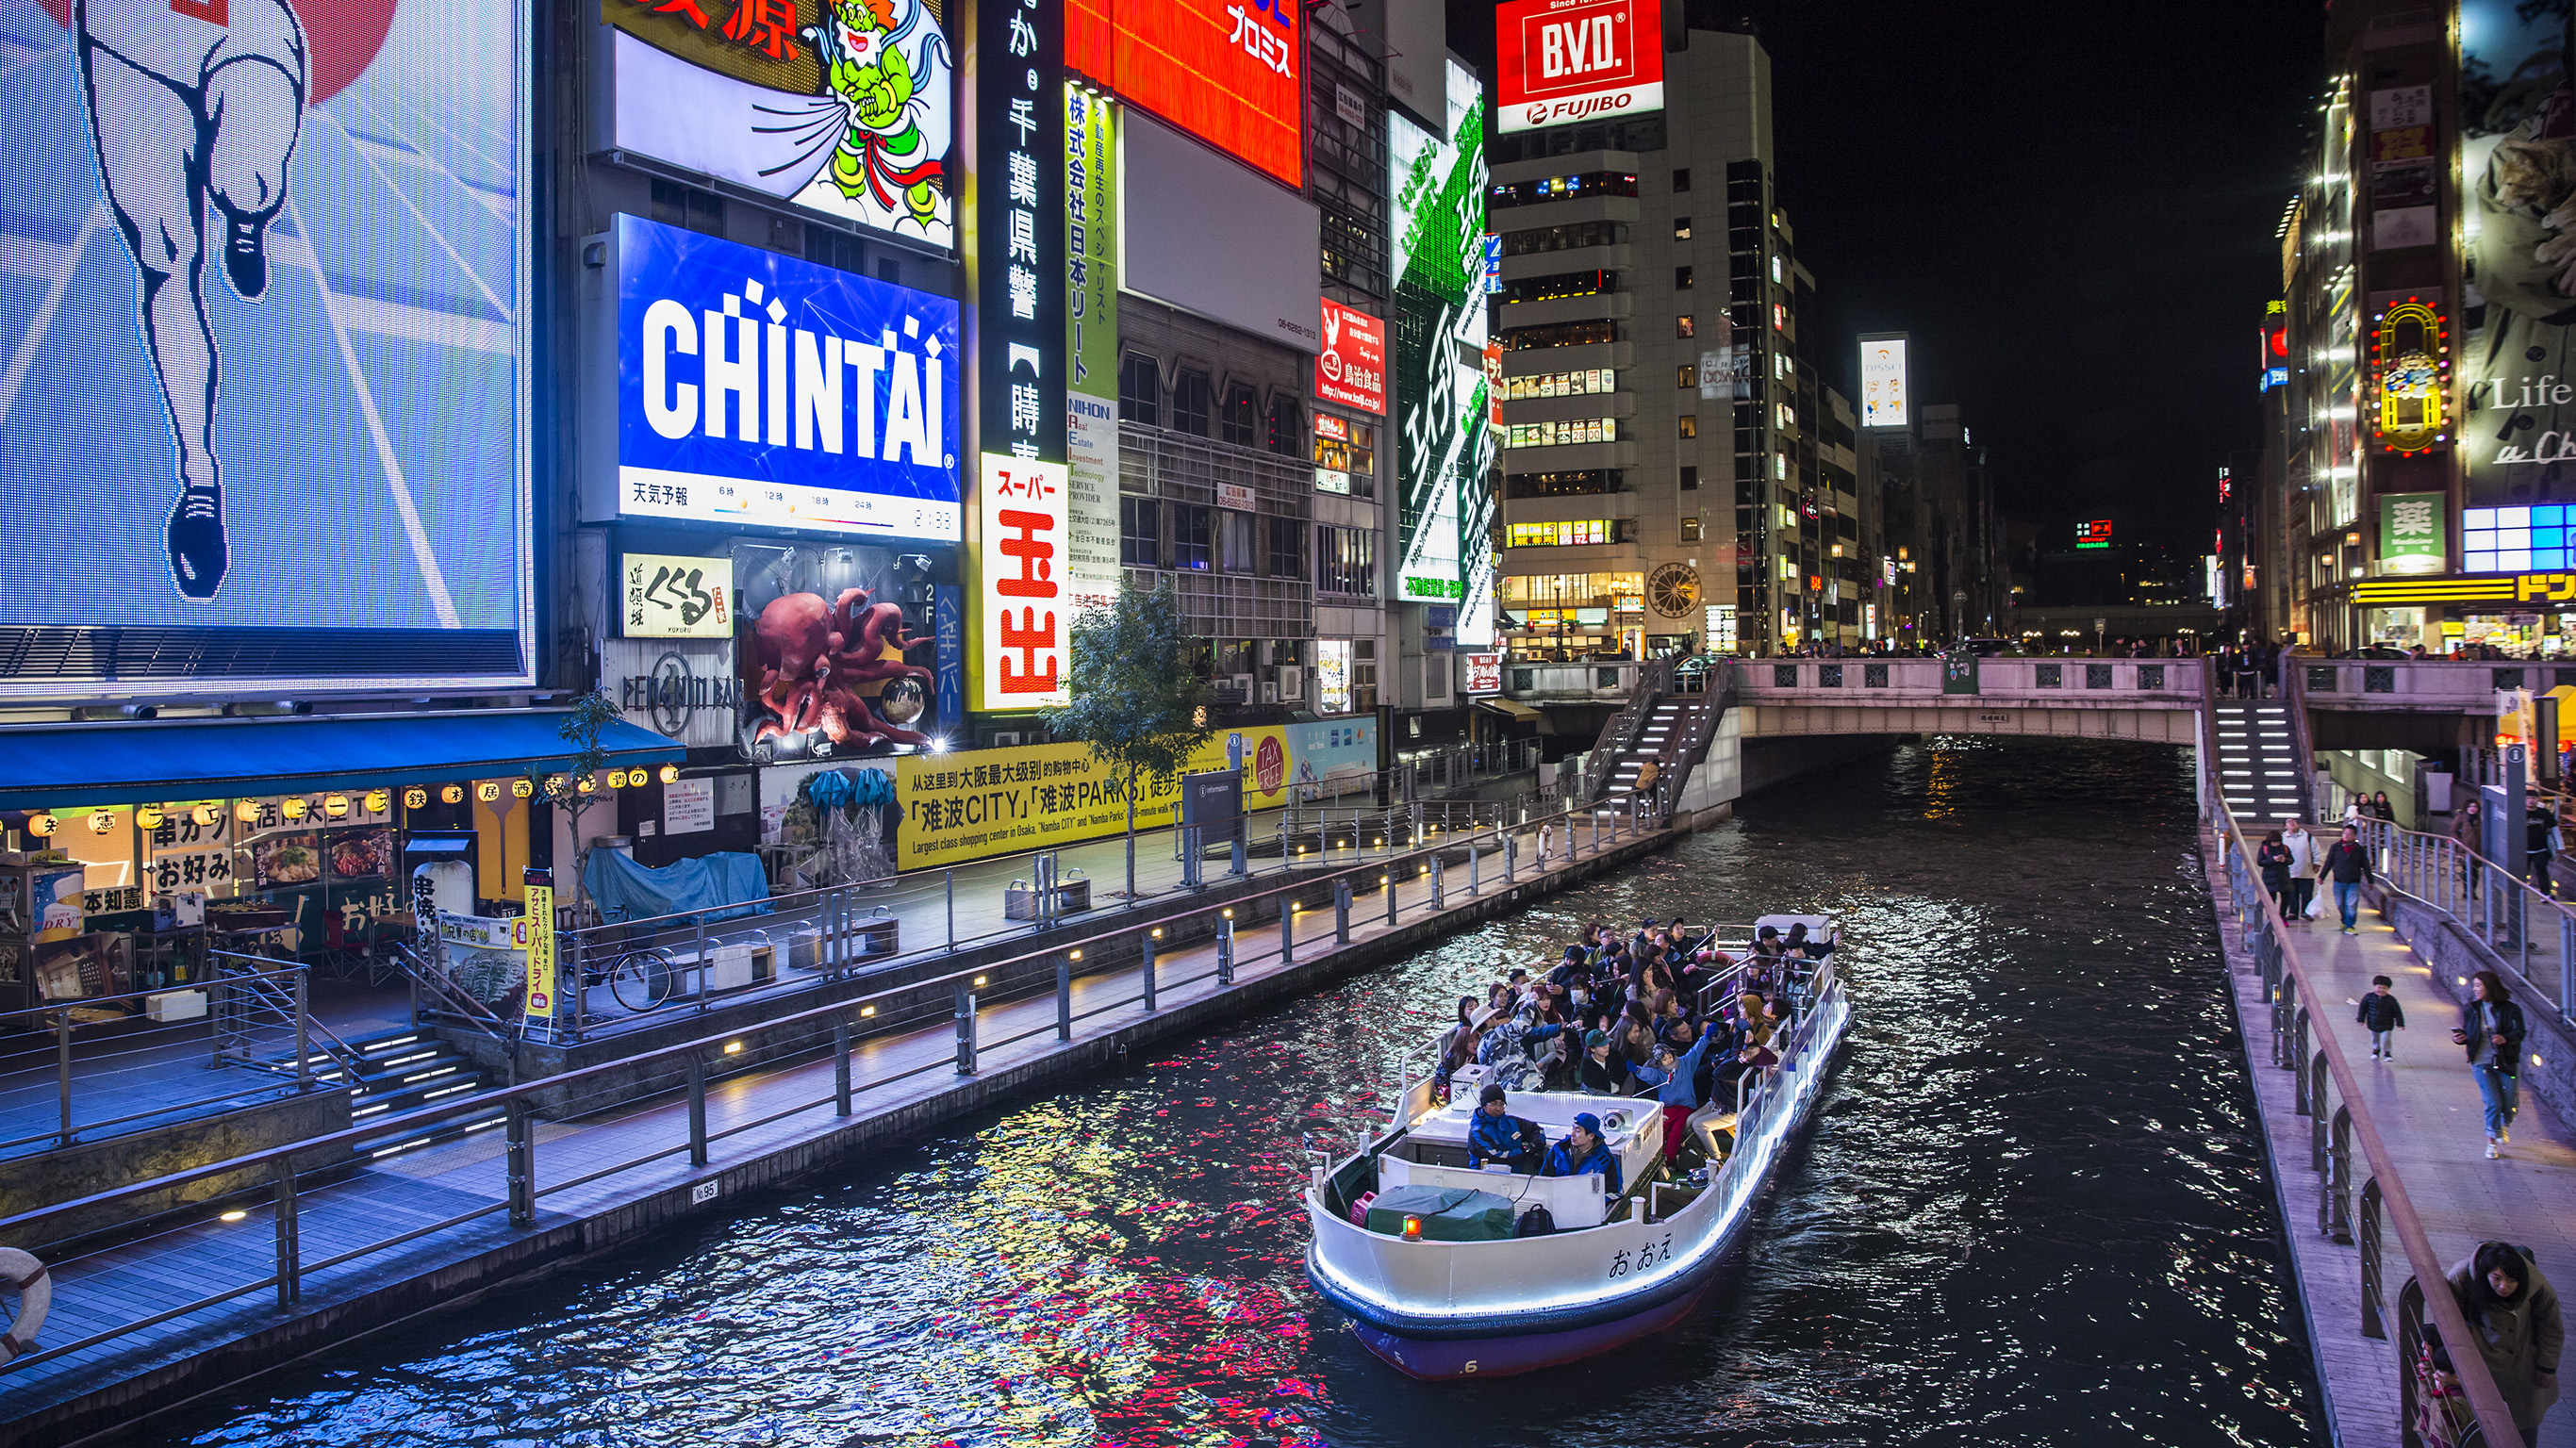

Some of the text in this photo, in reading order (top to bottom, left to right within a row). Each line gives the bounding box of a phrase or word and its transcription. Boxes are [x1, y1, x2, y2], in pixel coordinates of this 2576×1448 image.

[1227, 4, 1292, 79] プロミス
[1542, 15, 1622, 78] B.V.D.
[1552, 92, 1632, 120] FUJIBO
[1009, 0, 1038, 321] か。千葉県警
[1094, 106, 1107, 326] 不動産再生のスペシャリスト
[1067, 92, 1089, 386] 株式会社日本リート
[1278, 318, 1316, 340] 06-6262-1313
[643, 277, 943, 469] CHINTAI
[2488, 375, 2574, 410] Life
[1068, 397, 1111, 421] NIHON
[1068, 414, 1088, 432] Real
[1068, 431, 1094, 449] Estate
[1068, 447, 1104, 466] Investment
[998, 470, 1055, 502] スーパー
[1068, 480, 1096, 493] SERVICE
[1069, 463, 1105, 483] Technology
[633, 482, 688, 507] 天気予報
[718, 485, 734, 498] 6時
[765, 490, 784, 502] 12時
[812, 495, 830, 506] 18時
[1068, 491, 1101, 503] PROVIDER
[854, 500, 873, 511] 24時
[2392, 502, 2433, 535] 薬
[1649, 565, 1700, 587] FRUITS TOWER
[644, 566, 713, 626] くくる
[926, 584, 934, 624] 2F
[997, 508, 1058, 694] 玉出
[1259, 741, 1280, 767] TAX
[633, 773, 645, 783] の
[912, 757, 1091, 793] 从这里到大阪最大级别的购物中心
[1258, 761, 1283, 790] FREE!
[408, 792, 425, 806] 鉄
[1206, 784, 1229, 794] information
[913, 835, 939, 856] Largest
[940, 834, 958, 852] class
[959, 831, 988, 847] shopping
[989, 828, 1009, 842] center
[1010, 827, 1016, 838] in
[1016, 824, 1037, 841] Osaka,
[1038, 819, 1061, 833] "Namba
[1061, 815, 1076, 831] CITY"
[1077, 814, 1088, 829] and
[1088, 812, 1109, 826] "Namba
[1158, 802, 1170, 815] walk
[158, 851, 231, 888] お好み
[85, 887, 141, 913] 本知憲
[531, 888, 543, 992] アサヒスーパードライ
[1608, 1232, 1673, 1280] おおえ
